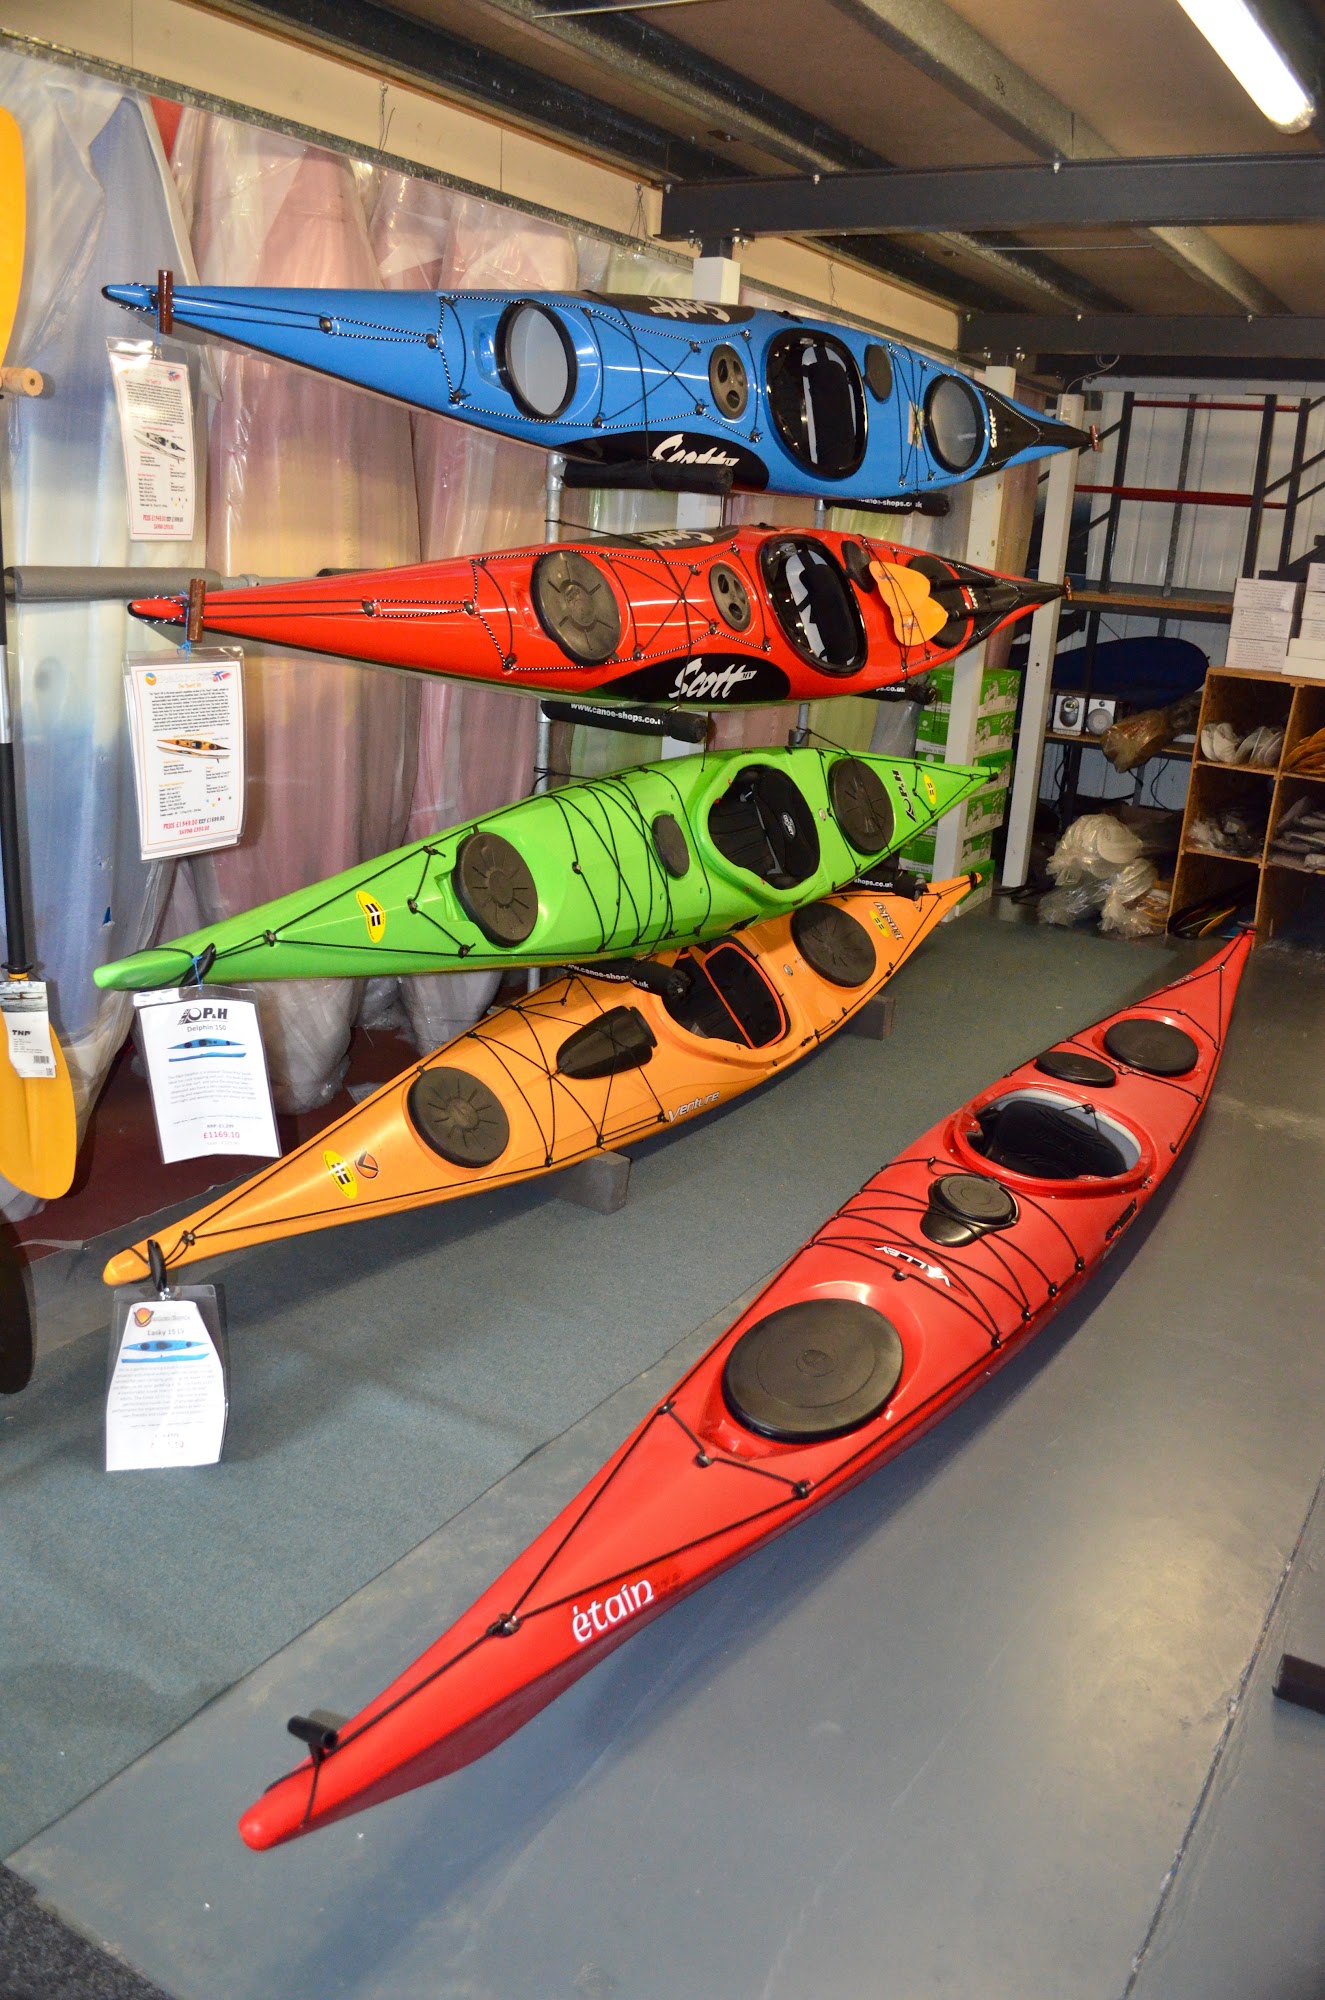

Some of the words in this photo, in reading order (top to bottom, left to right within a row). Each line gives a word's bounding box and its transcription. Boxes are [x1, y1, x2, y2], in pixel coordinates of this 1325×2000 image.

[668, 658, 757, 699] Scott
[12, 1029, 32, 1037] TNP
[187, 1024, 214, 1032] Delphin
[668, 1090, 720, 1123] Venture
[874, 1245, 950, 1287] VALLEY
